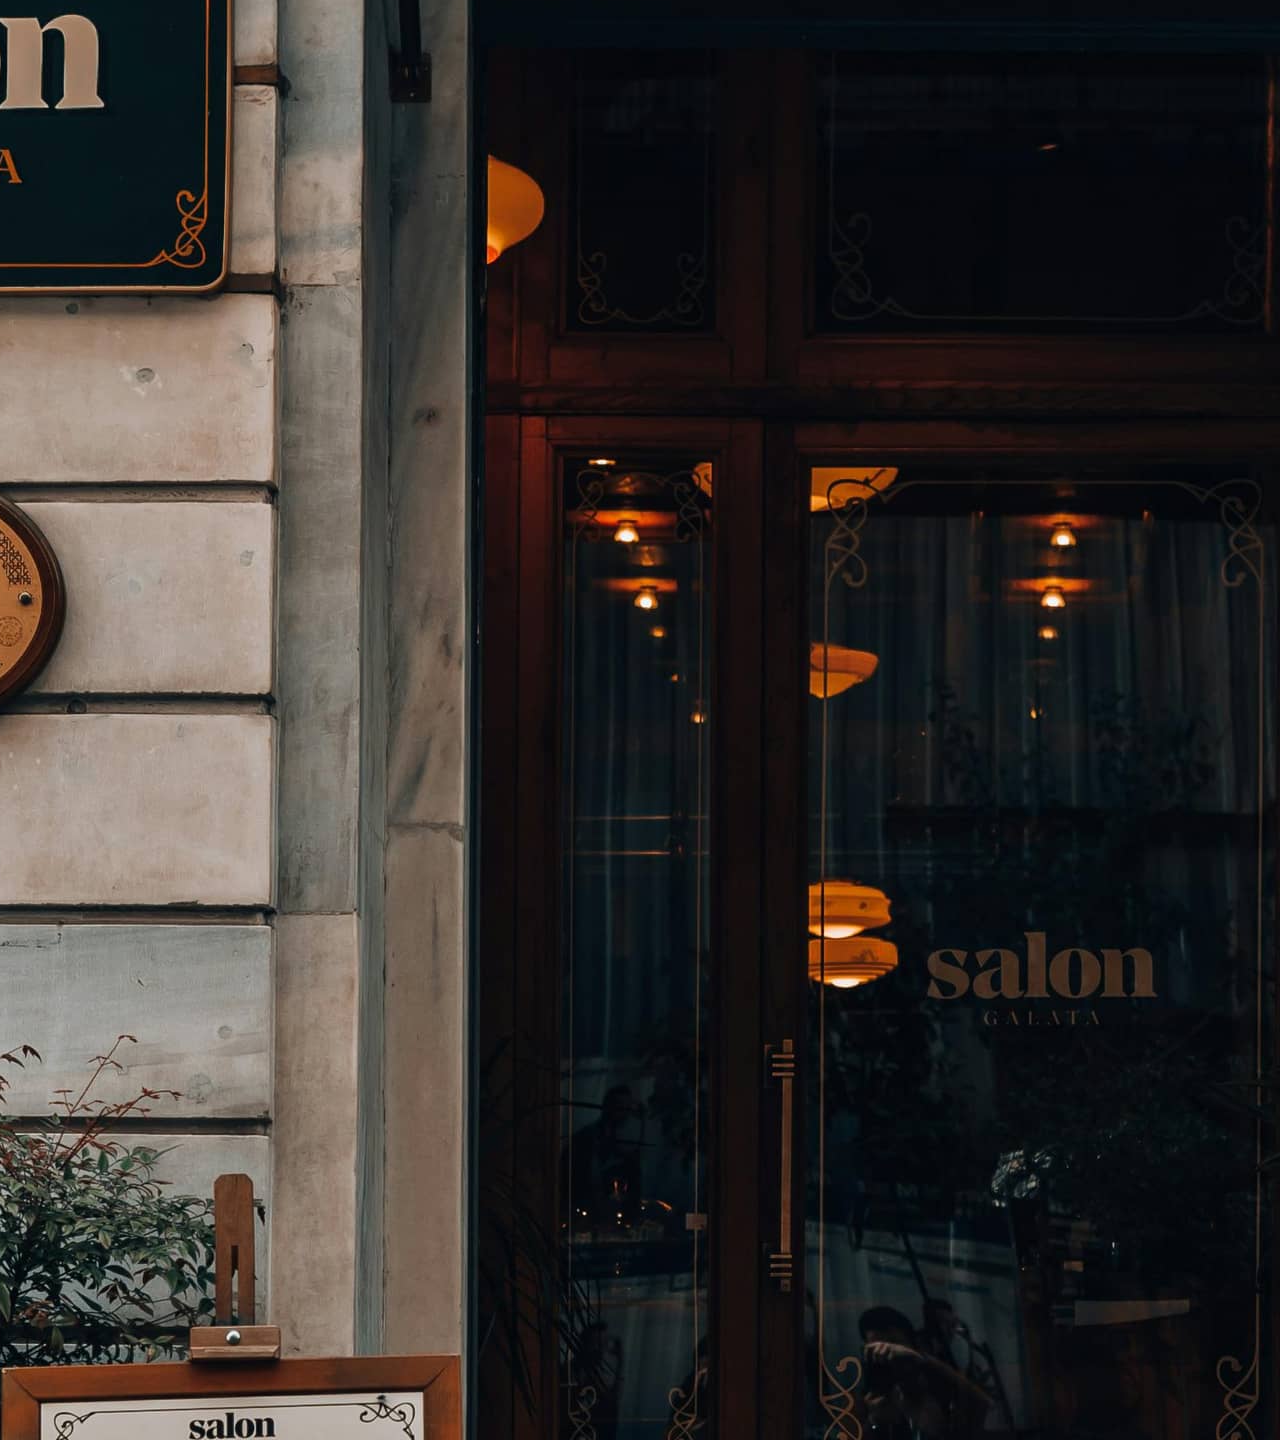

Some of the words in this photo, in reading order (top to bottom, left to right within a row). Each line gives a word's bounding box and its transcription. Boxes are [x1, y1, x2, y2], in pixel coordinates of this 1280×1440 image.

[927, 931, 1158, 1000] salon
[983, 1009, 1102, 1026] GALATA
[189, 1412, 275, 1440] salon
